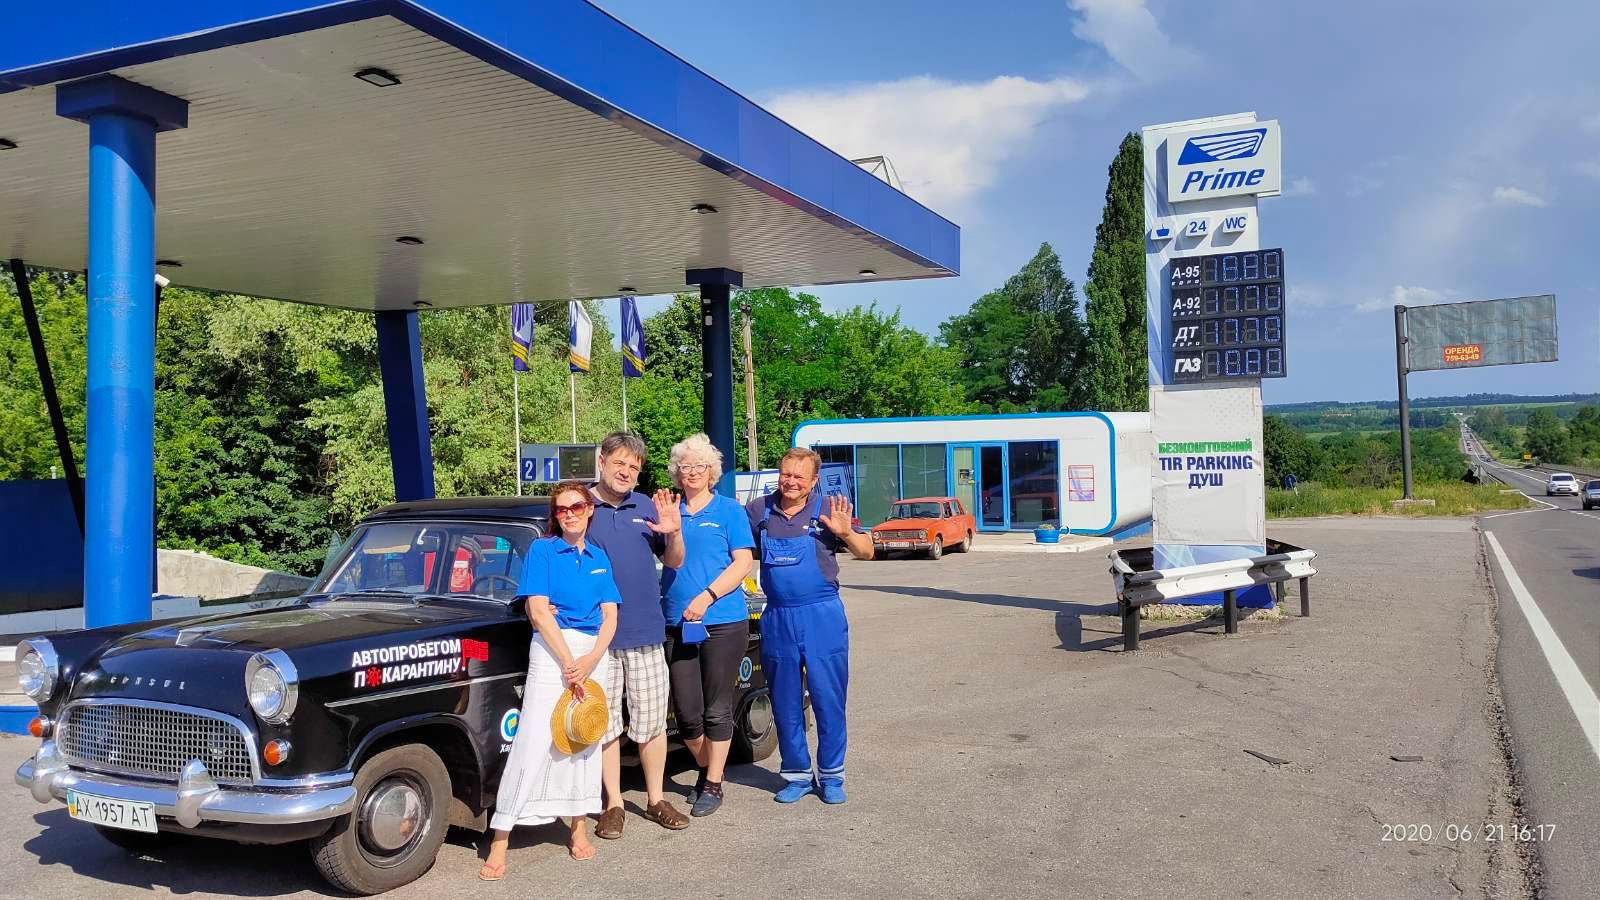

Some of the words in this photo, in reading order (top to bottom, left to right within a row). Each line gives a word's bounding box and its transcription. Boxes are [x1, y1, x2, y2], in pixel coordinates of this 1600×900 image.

[1180, 168, 1265, 193] Prime
[1189, 220, 1207, 233] 24
[1225, 216, 1247, 229] WC
[1172, 265, 1200, 280] А-95
[1173, 296, 1200, 311] А-92
[1175, 326, 1199, 343] ДТ
[1444, 346, 1480, 355] ОРЕНДА
[1174, 358, 1201, 373] ГАЗ
[525, 460, 534, 480] 2
[547, 460, 554, 480] 1
[1159, 456, 1183, 471] TIR
[1186, 455, 1253, 471] PARKING
[1188, 472, 1224, 489] ДУШ
[351, 638, 462, 669] АВТОПРОБЕГОМ
[76, 796, 93, 818] AX
[95, 801, 125, 825] 1957
[131, 806, 150, 828] AT
